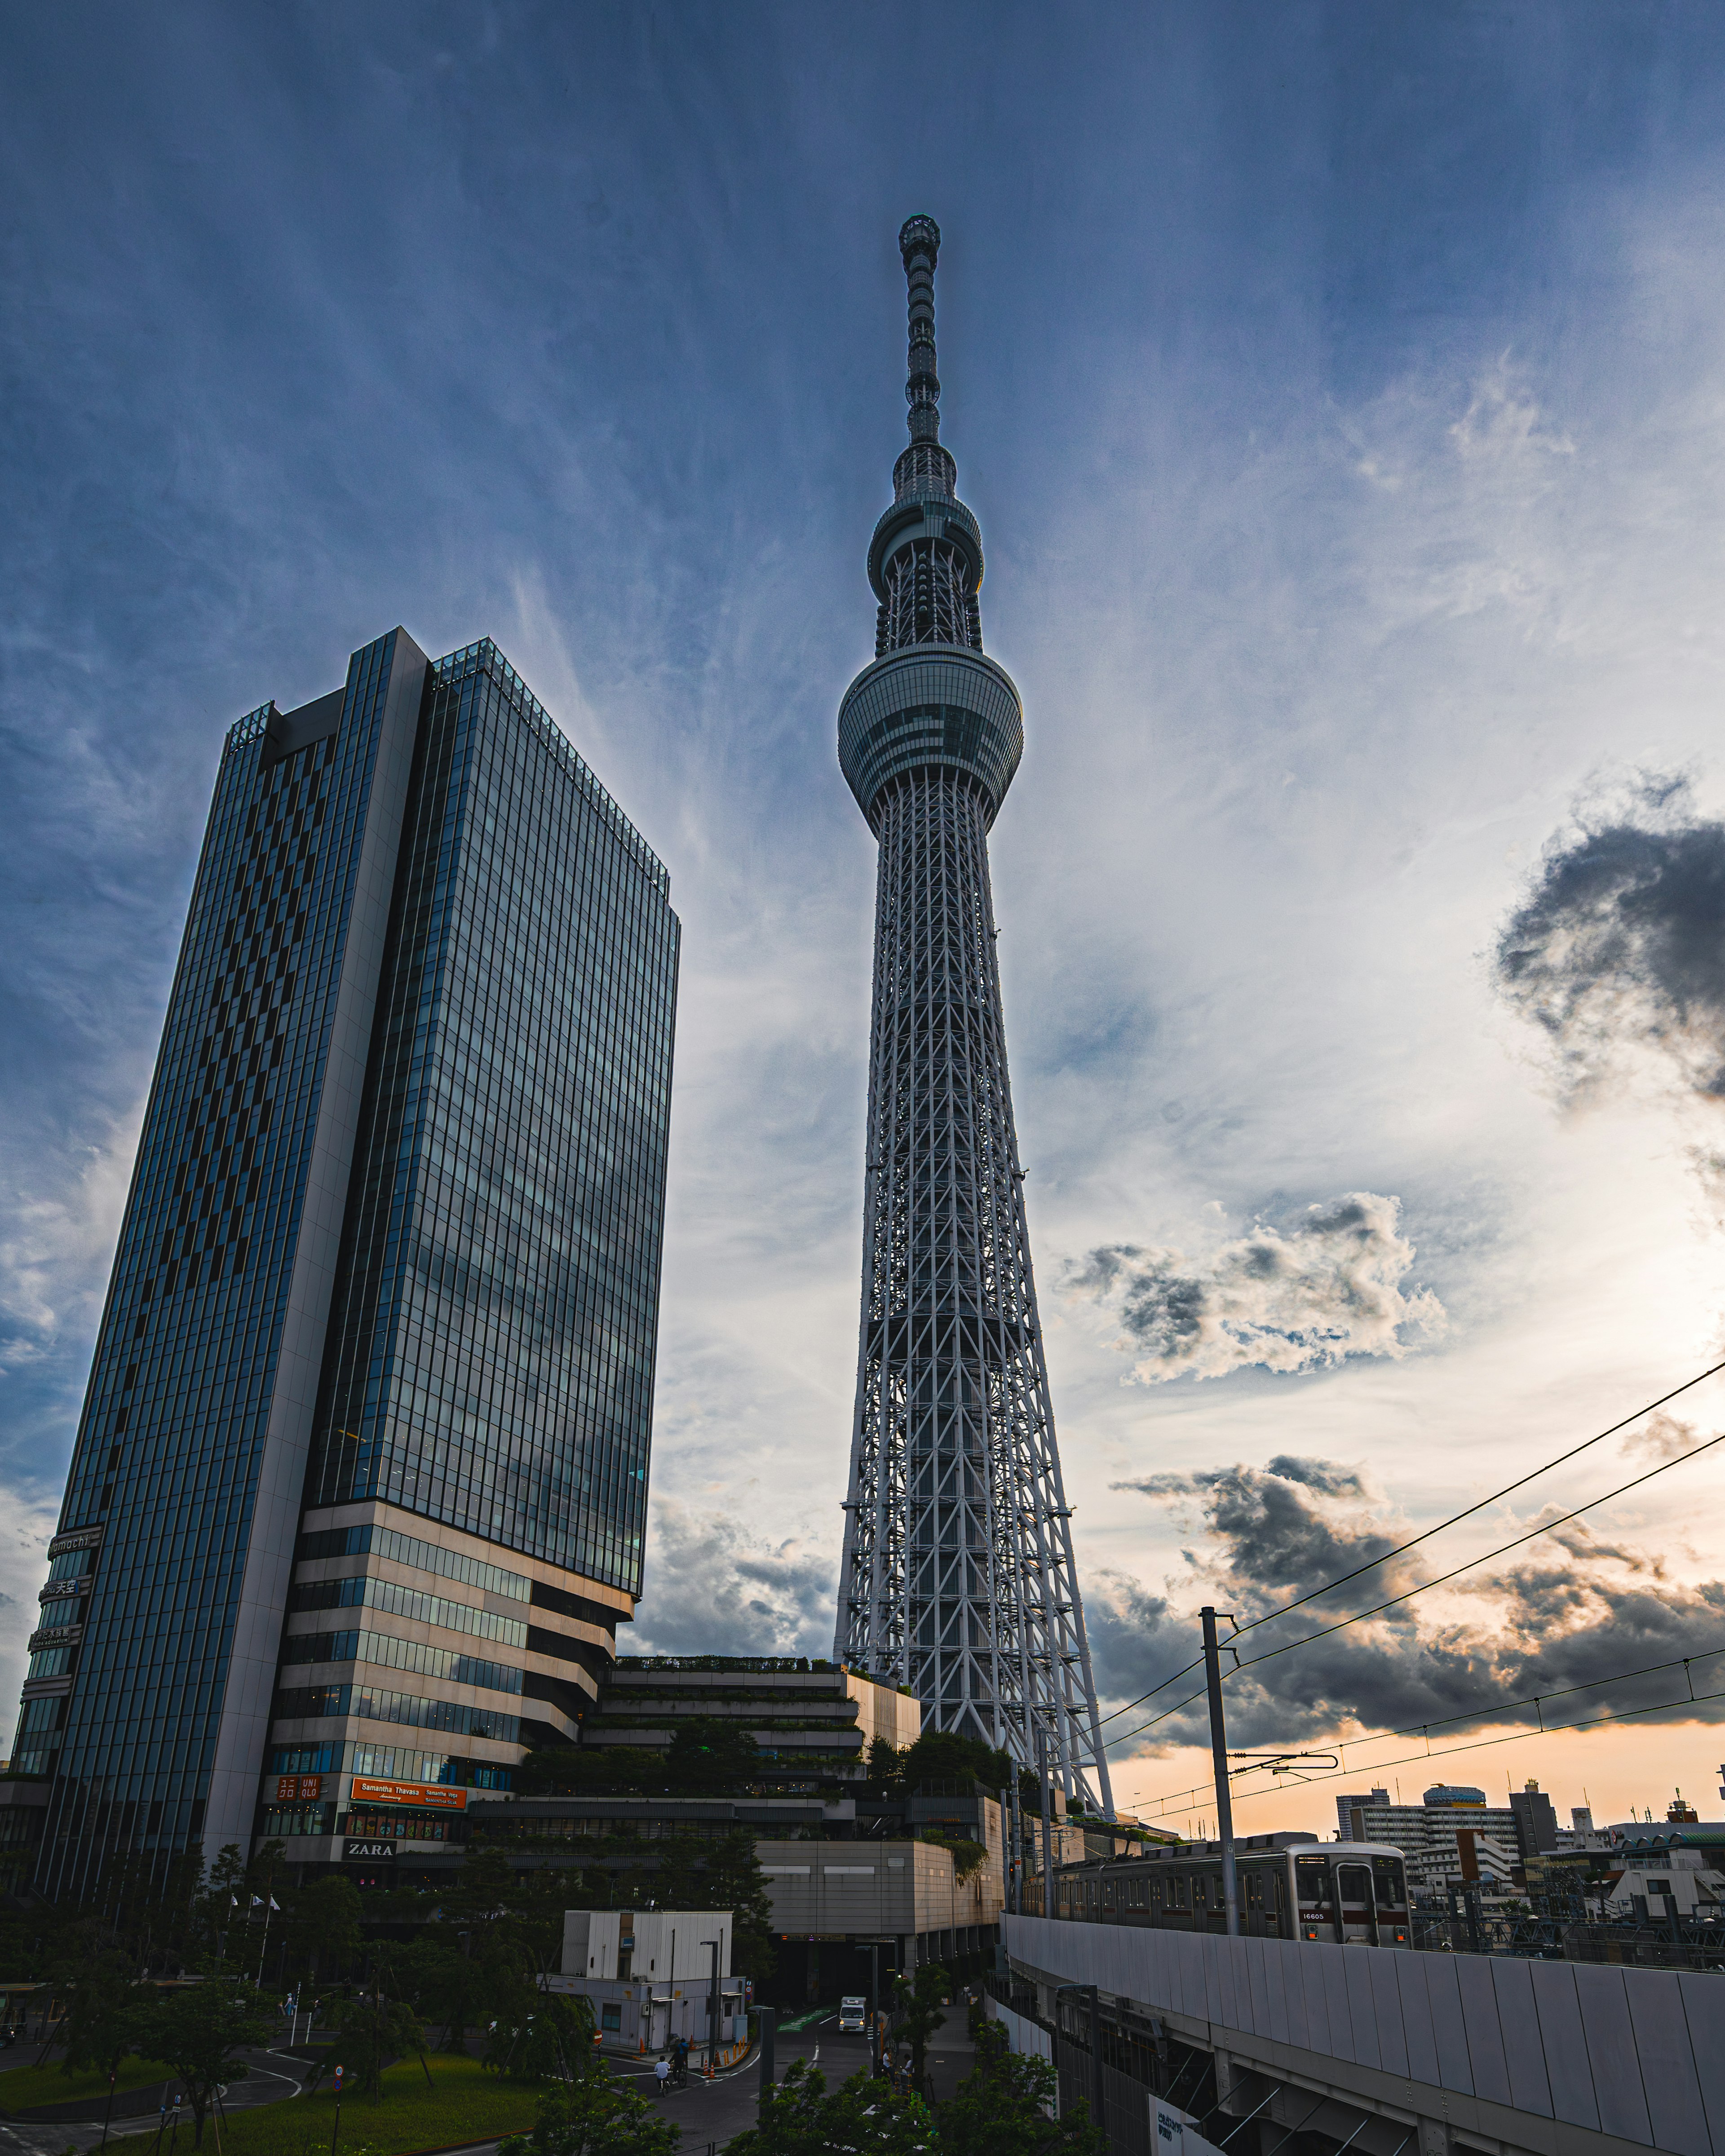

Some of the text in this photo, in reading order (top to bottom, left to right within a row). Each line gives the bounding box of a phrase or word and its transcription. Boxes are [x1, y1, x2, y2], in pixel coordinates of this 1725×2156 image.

[281, 1780, 295, 1788] ユニ
[303, 1779, 317, 1787] UNI
[279, 1789, 294, 1798] クロ
[301, 1788, 317, 1798] QLO
[362, 1783, 419, 1796] Samantha Thavasa
[348, 1844, 393, 1856] ZARA
